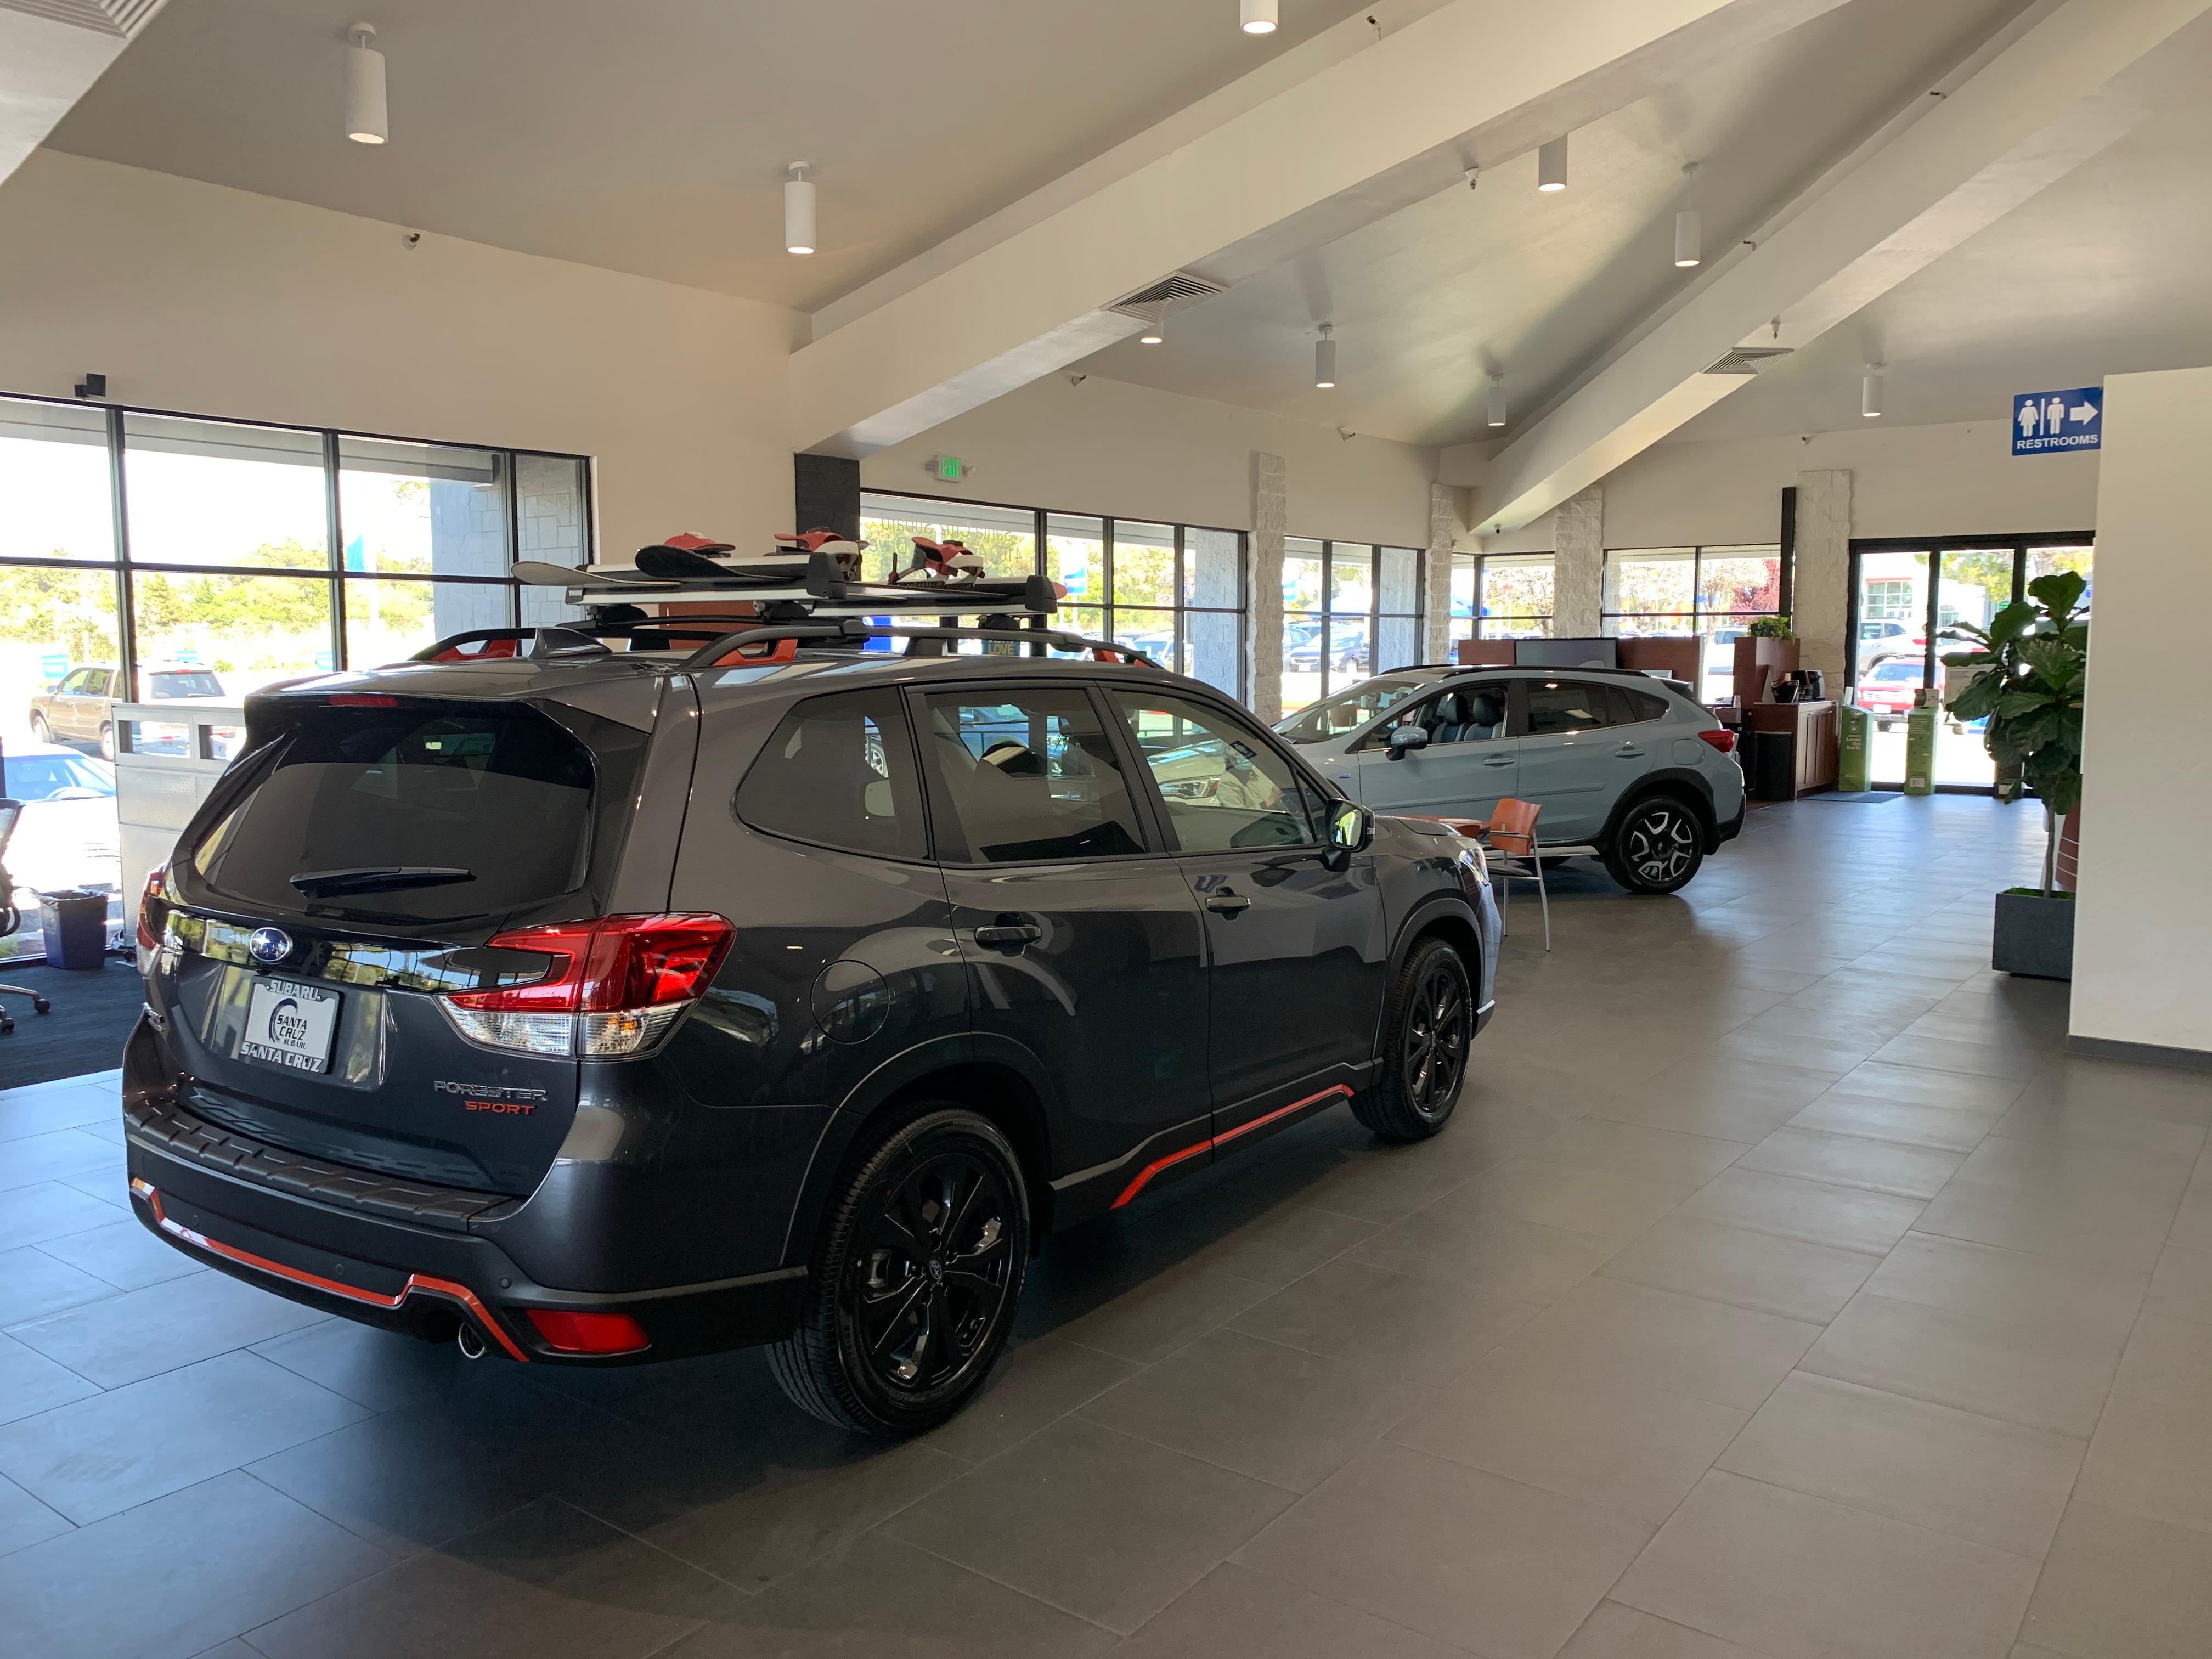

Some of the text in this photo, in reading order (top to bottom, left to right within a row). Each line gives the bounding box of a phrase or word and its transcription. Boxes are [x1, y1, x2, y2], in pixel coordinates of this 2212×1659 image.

[2017, 434, 2098, 449] RESTROOMS
[942, 456, 960, 478] EXIT
[988, 644, 1014, 655] LOVE
[270, 980, 319, 1001] SUBARU
[276, 1014, 307, 1030] SANTA
[279, 1026, 307, 1041] CRUZ
[283, 1038, 308, 1049] SUBARU
[241, 1042, 324, 1073] SANTA CRUZ
[434, 1080, 548, 1101] FORESTER
[465, 1100, 535, 1115] SPORT
